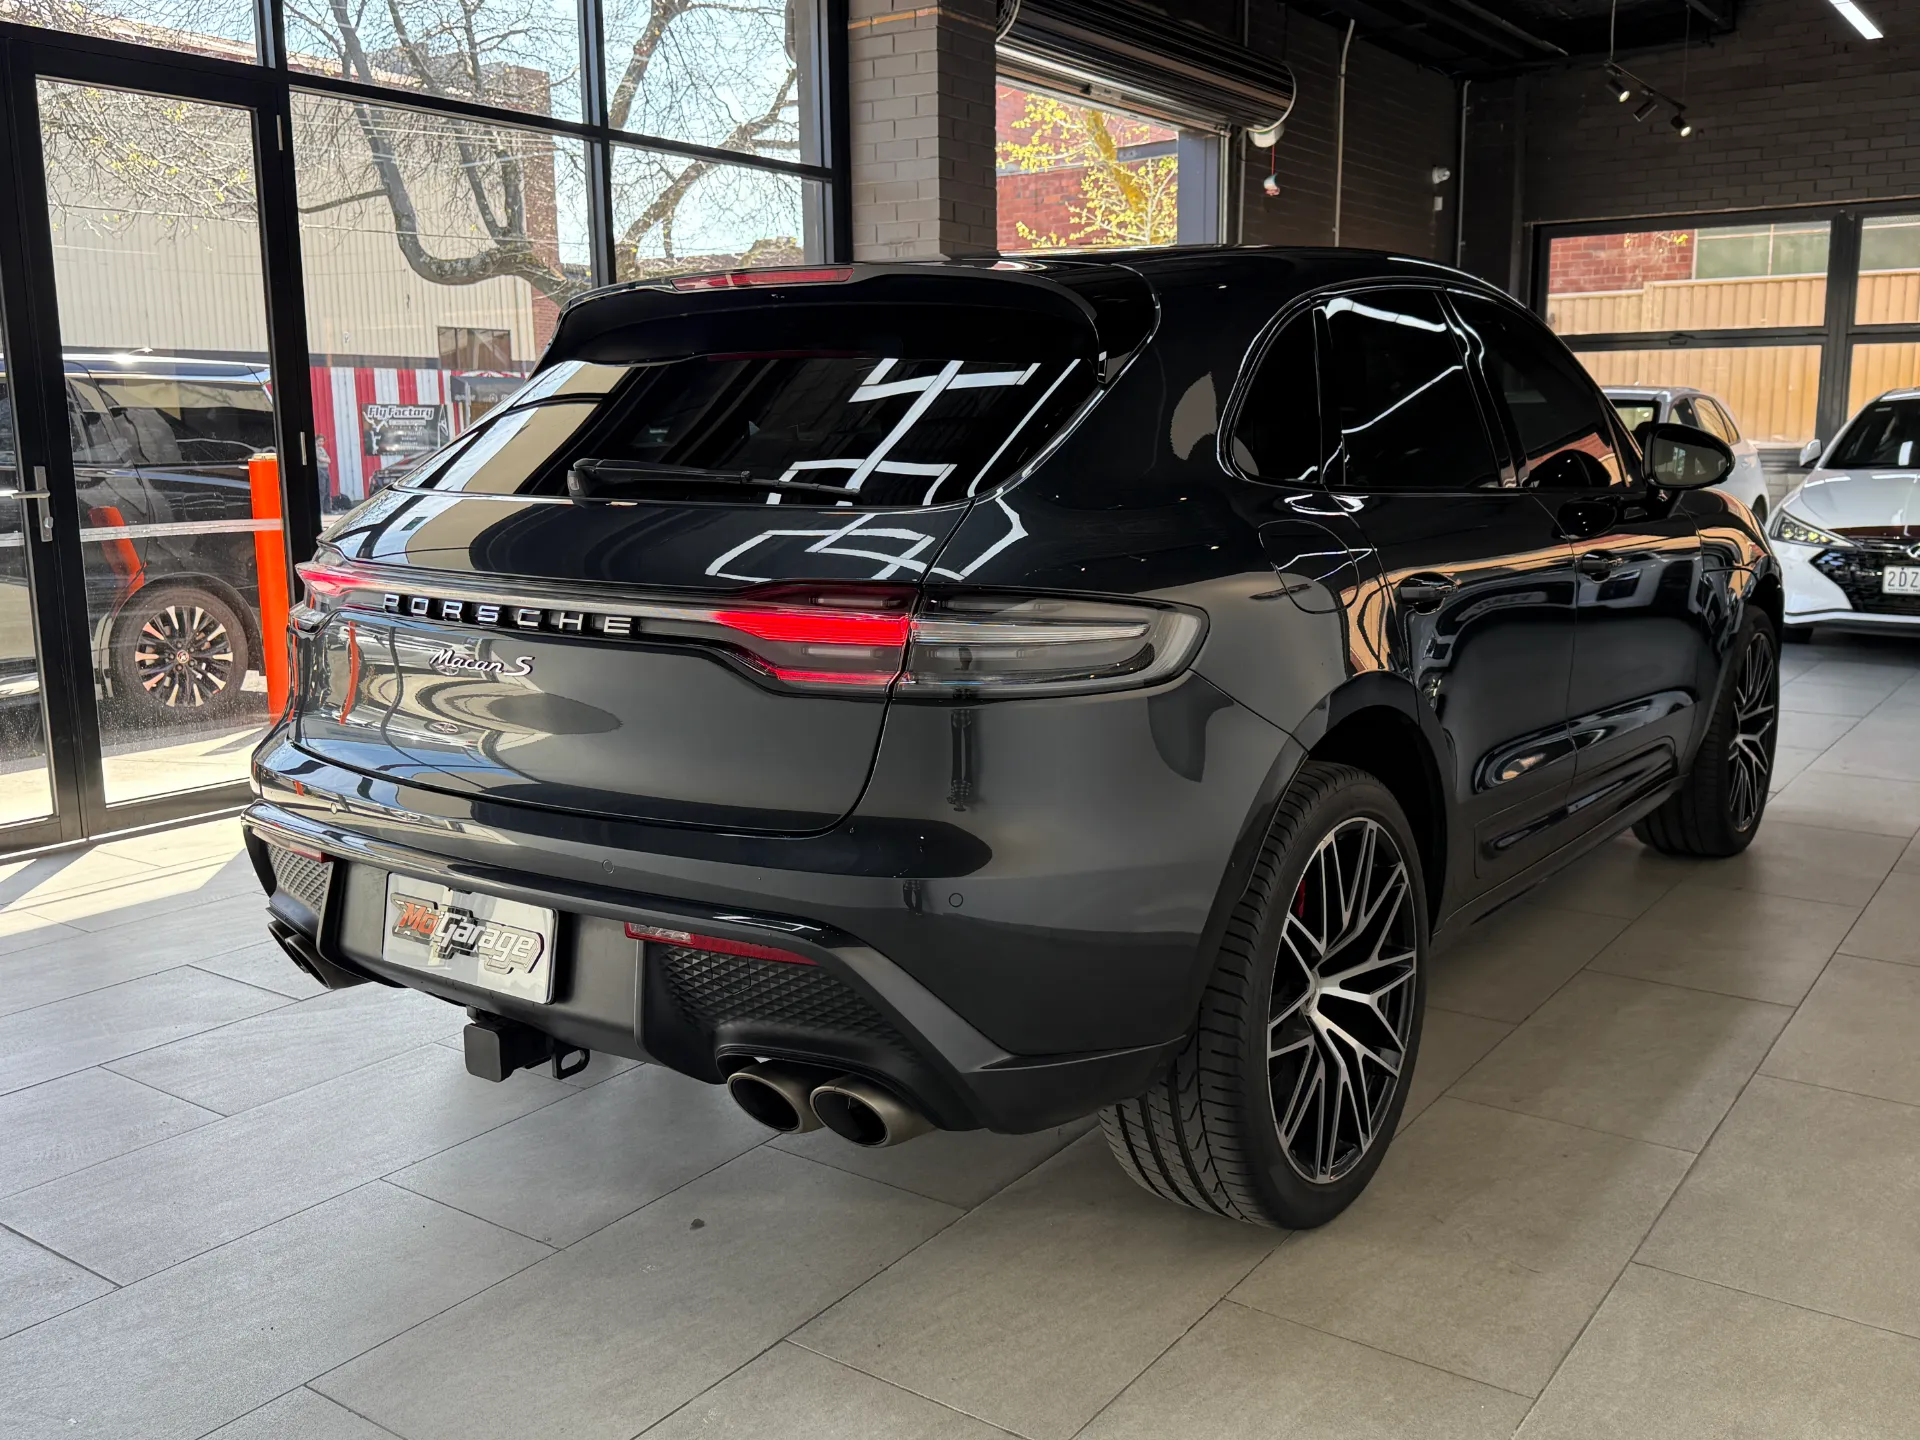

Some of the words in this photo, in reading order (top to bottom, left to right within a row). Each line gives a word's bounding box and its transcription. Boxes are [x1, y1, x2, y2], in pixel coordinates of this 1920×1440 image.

[368, 405, 387, 419] Fly
[388, 406, 434, 420] Factory
[383, 593, 632, 635] PORSCHE
[429, 648, 504, 673] Macan
[503, 656, 535, 676] S
